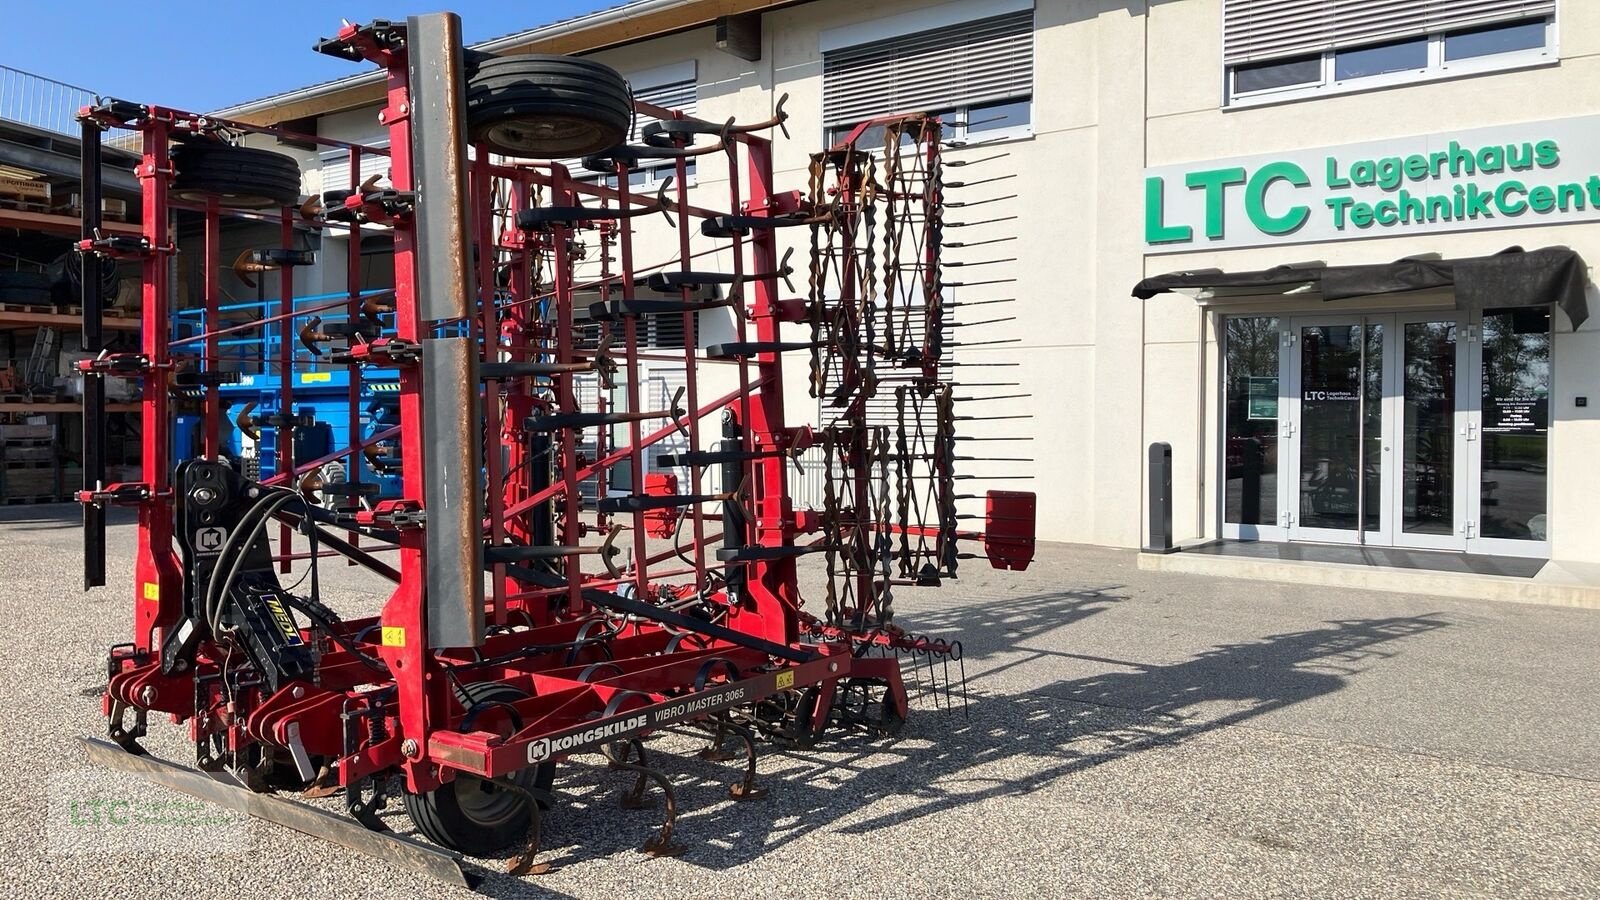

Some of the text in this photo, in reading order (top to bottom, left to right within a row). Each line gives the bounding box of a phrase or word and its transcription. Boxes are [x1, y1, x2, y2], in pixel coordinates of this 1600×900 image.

[1327, 139, 1559, 191] Lagerhaus
[1145, 161, 1311, 244] LTC
[1325, 175, 1600, 230] TechnikCent
[1304, 391, 1326, 401] LTC
[266, 599, 296, 642] MEDL
[551, 714, 647, 753] KONGSKILDE
[654, 704, 685, 722] VIBRO
[687, 694, 723, 713] MASTER
[725, 688, 744, 702] 3065
